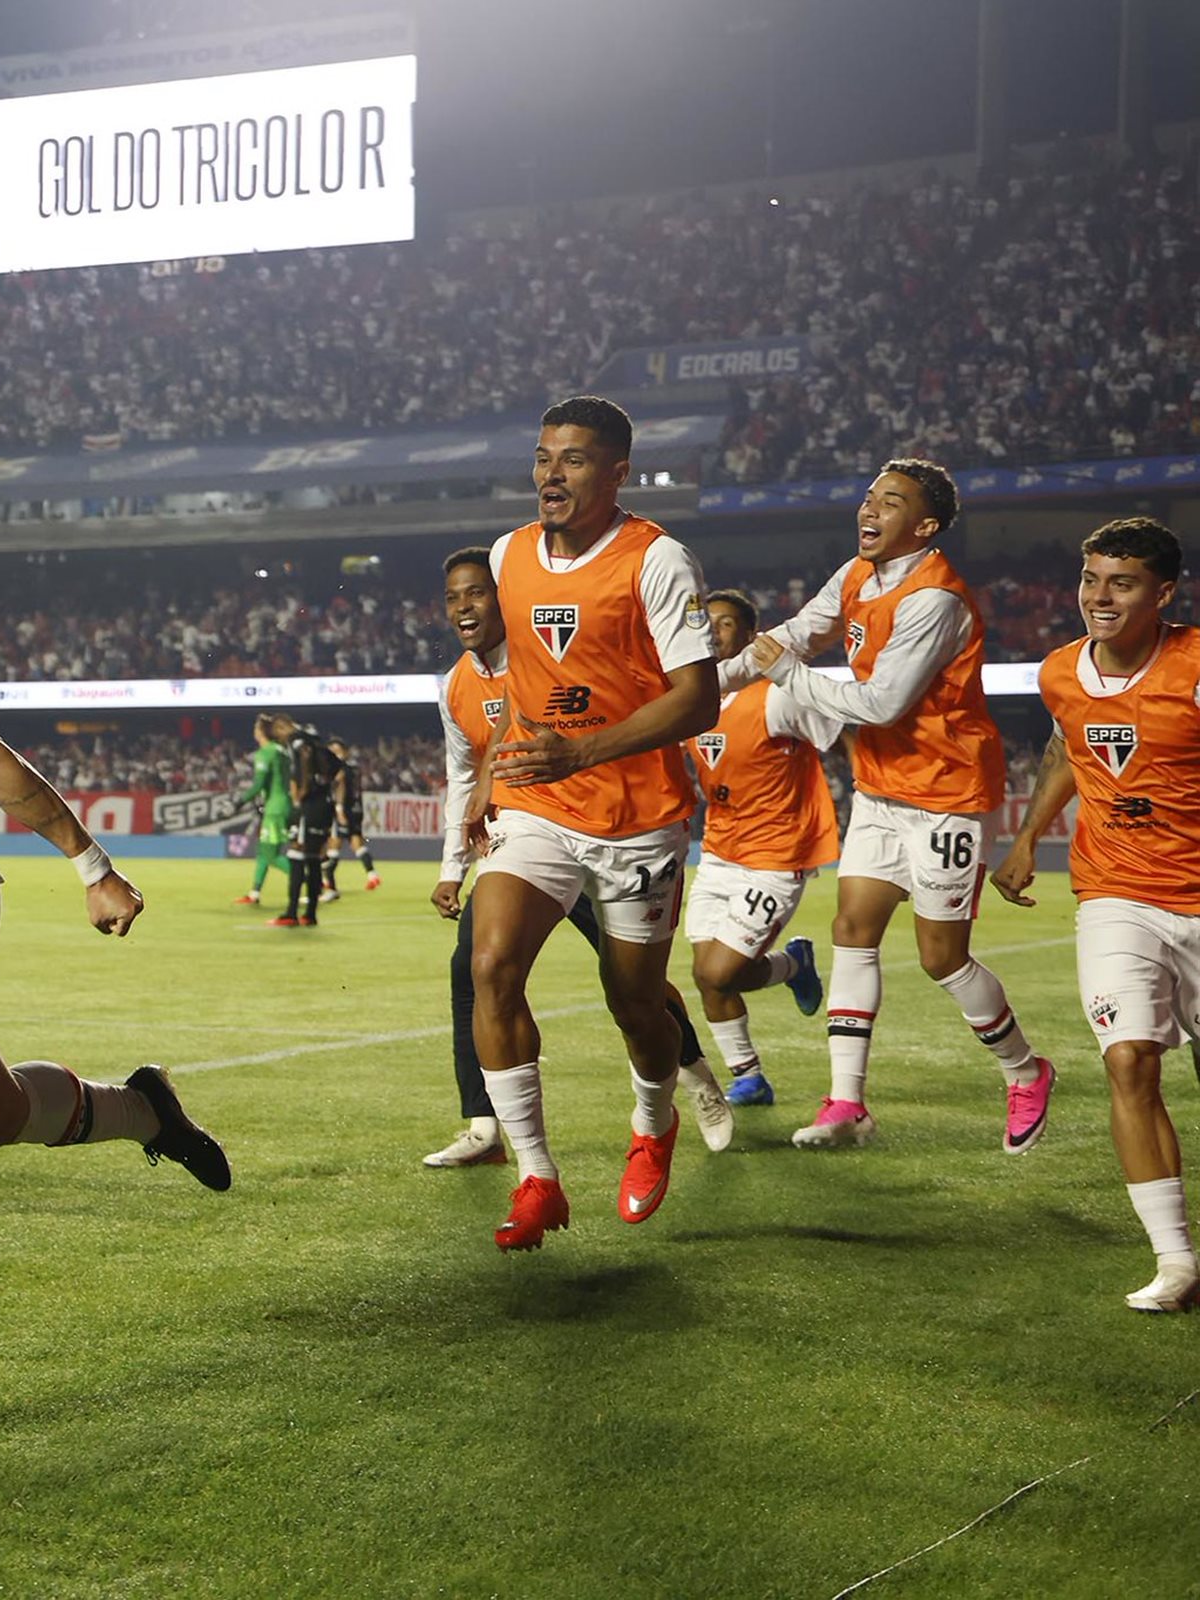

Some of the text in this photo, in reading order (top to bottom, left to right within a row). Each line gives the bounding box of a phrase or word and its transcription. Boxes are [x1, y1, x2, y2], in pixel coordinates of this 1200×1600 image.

[38, 105, 386, 219] GOL DO TRICOLOR
[647, 347, 800, 385] 4 EDCARLOS
[535, 610, 574, 623] SPFC
[487, 702, 502, 714] SP
[557, 715, 607, 730] balance
[1089, 728, 1133, 741] SPFC
[931, 832, 973, 869] 46
[744, 888, 777, 925] 49
